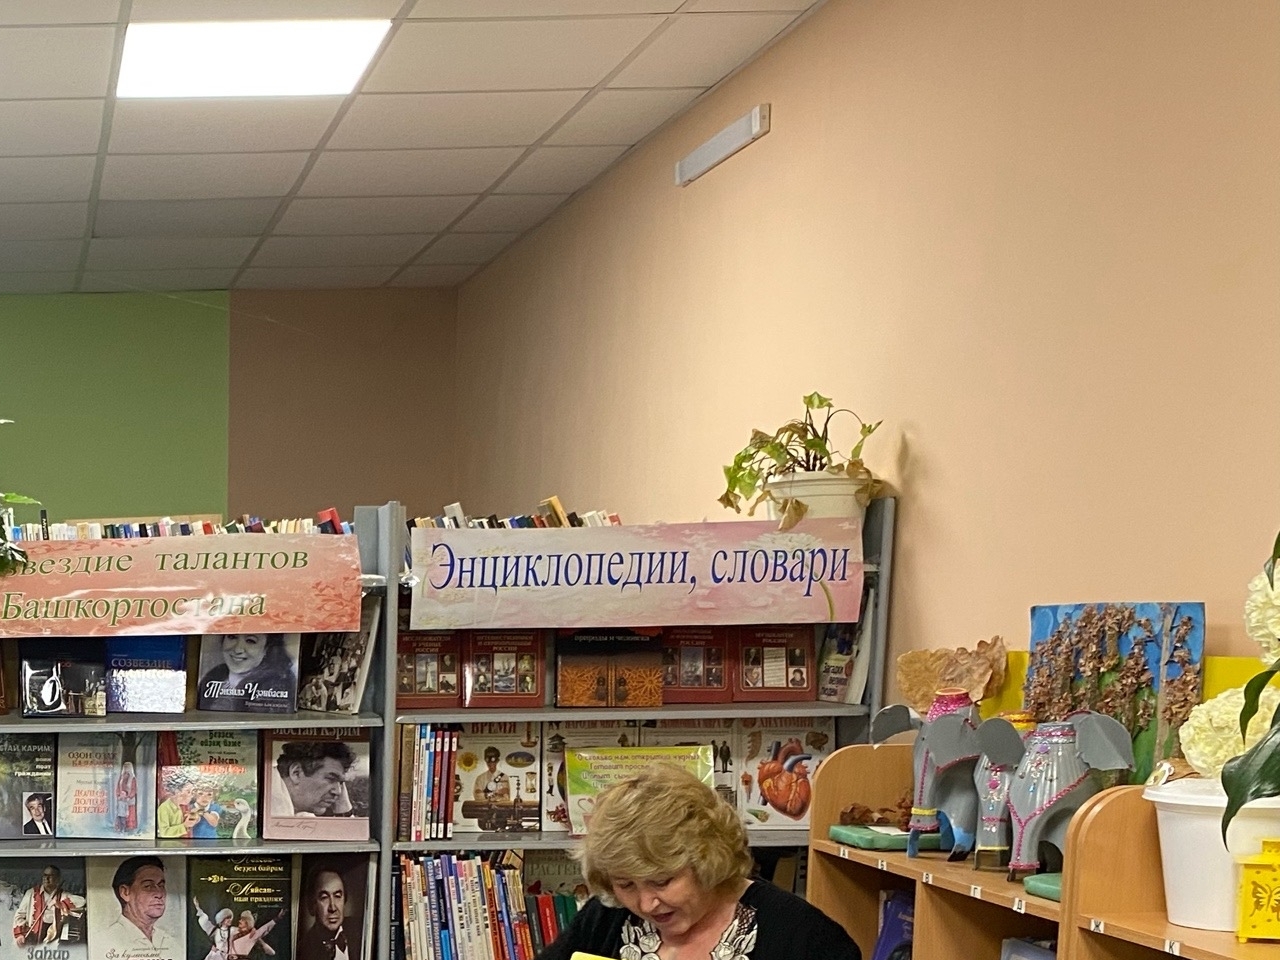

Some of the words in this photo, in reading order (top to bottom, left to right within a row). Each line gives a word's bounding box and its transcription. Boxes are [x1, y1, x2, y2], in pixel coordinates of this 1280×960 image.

[154, 547, 310, 574] талантов
[430, 541, 698, 596] Энциклопедии,
[711, 543, 852, 597] словари
[0, 591, 270, 628] Башкортостана
[110, 657, 172, 669] СОЗВЕЗДИЕ
[471, 722, 517, 734] ВРЕМЯ
[258, 864, 284, 873] байрам
[530, 863, 582, 876] РАСТЕН
